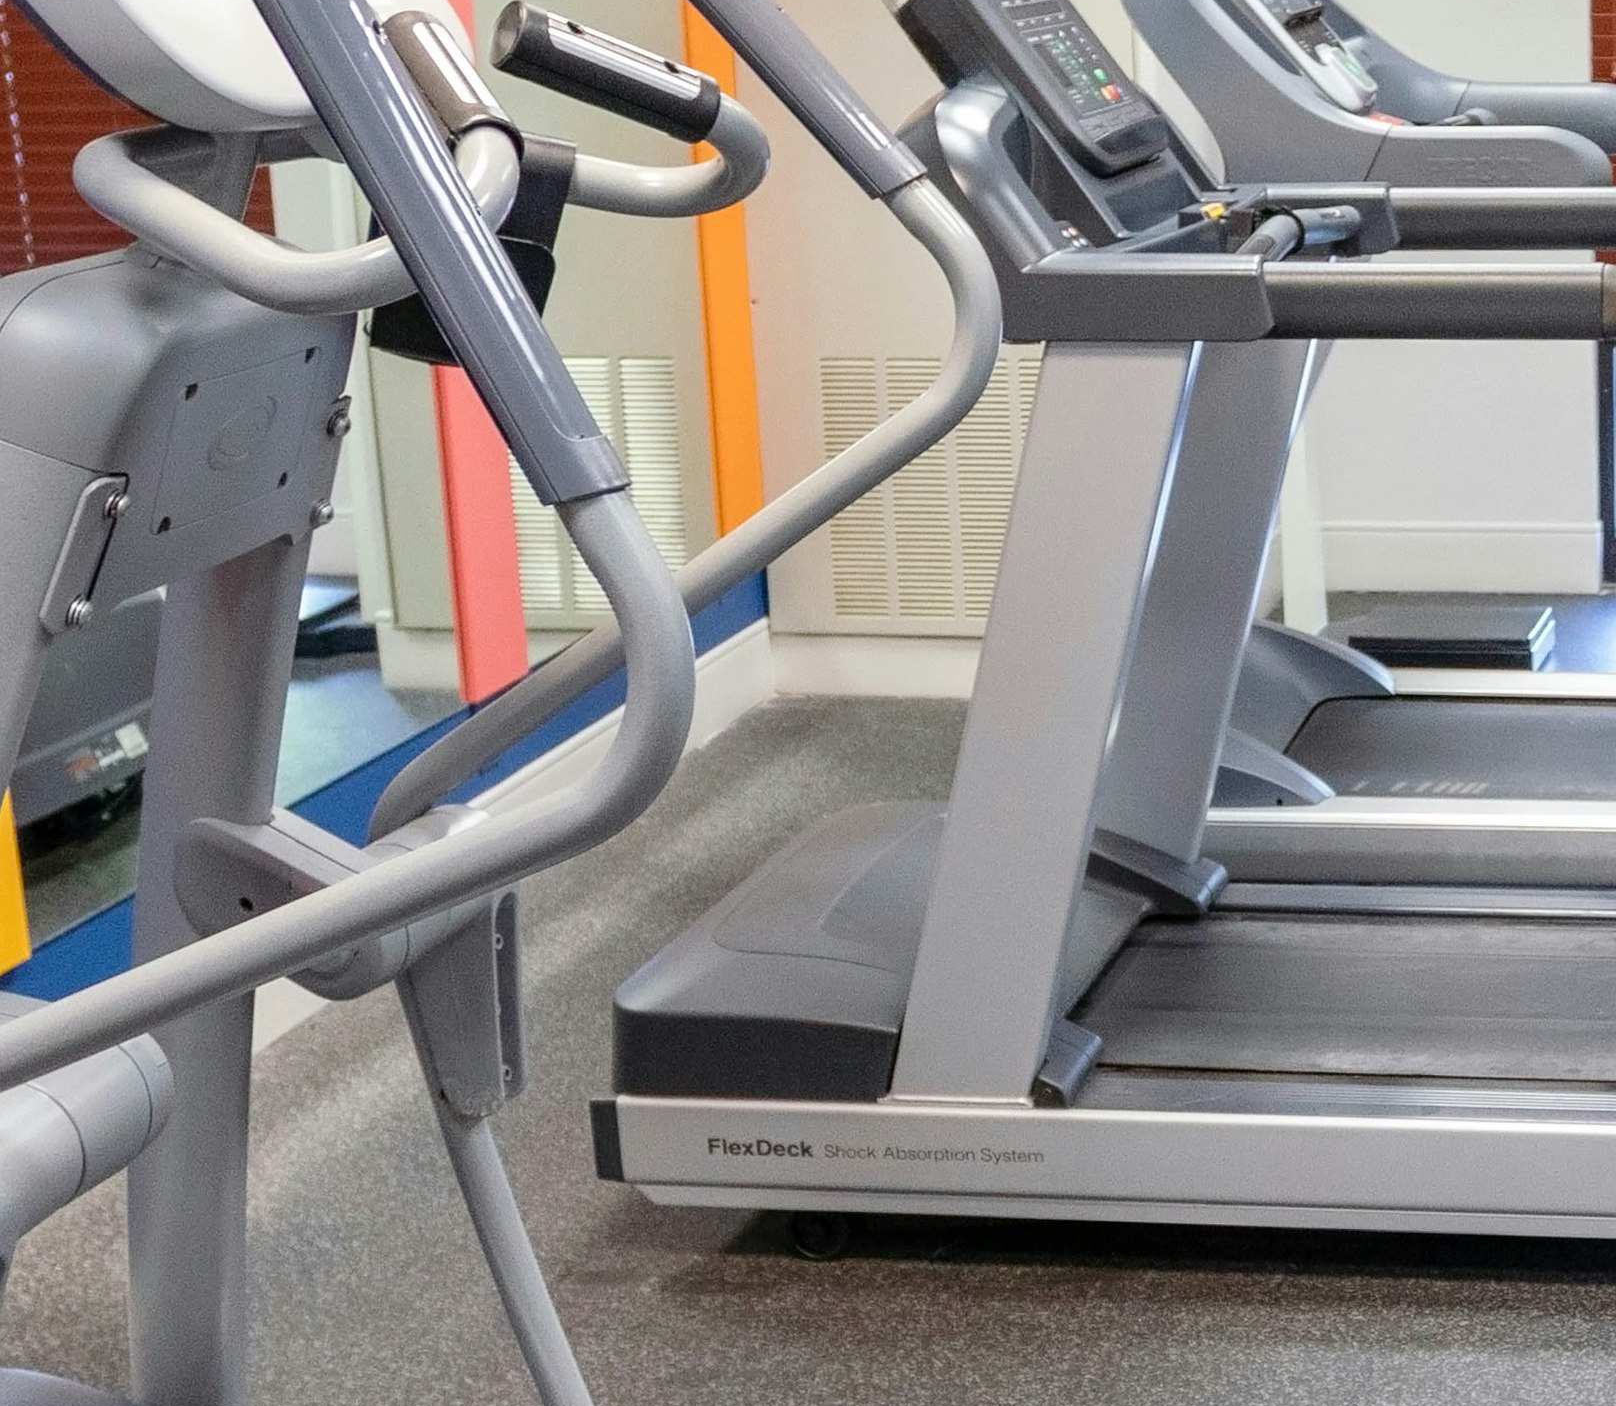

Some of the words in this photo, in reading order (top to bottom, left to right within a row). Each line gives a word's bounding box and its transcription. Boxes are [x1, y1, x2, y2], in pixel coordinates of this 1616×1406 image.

[707, 1138, 813, 1158] FlexDeck
[824, 1144, 877, 1160] Shock
[883, 1147, 976, 1165] Absorption
[980, 1147, 1045, 1164] System
